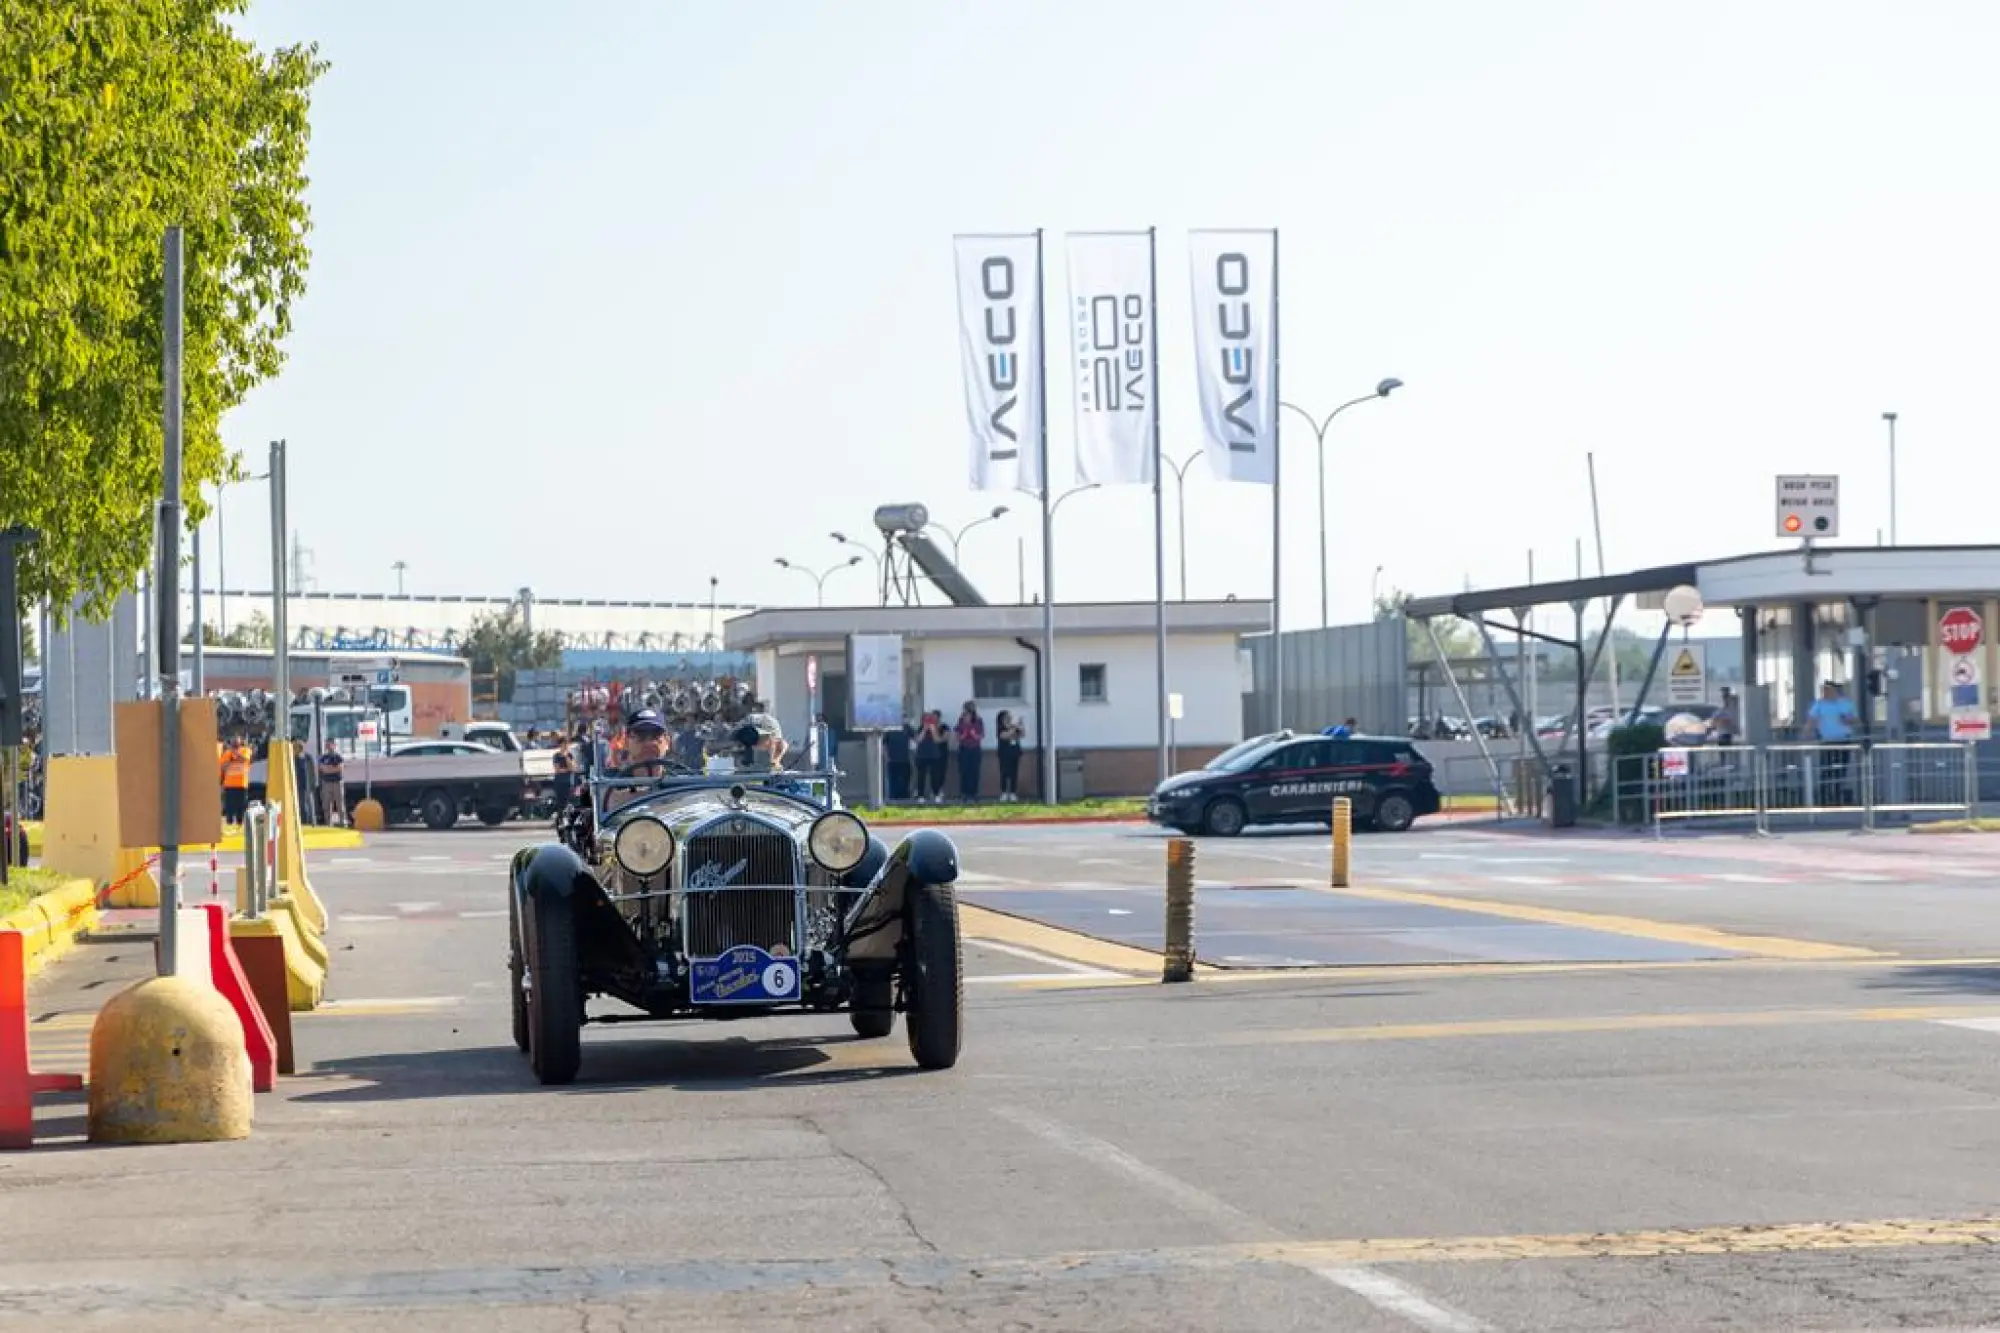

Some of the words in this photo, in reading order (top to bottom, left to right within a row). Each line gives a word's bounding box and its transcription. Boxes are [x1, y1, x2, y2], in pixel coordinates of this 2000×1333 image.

[1943, 623, 1979, 642] STOP
[1270, 780, 1362, 797] CARABINIERI
[773, 969, 784, 988] 6
